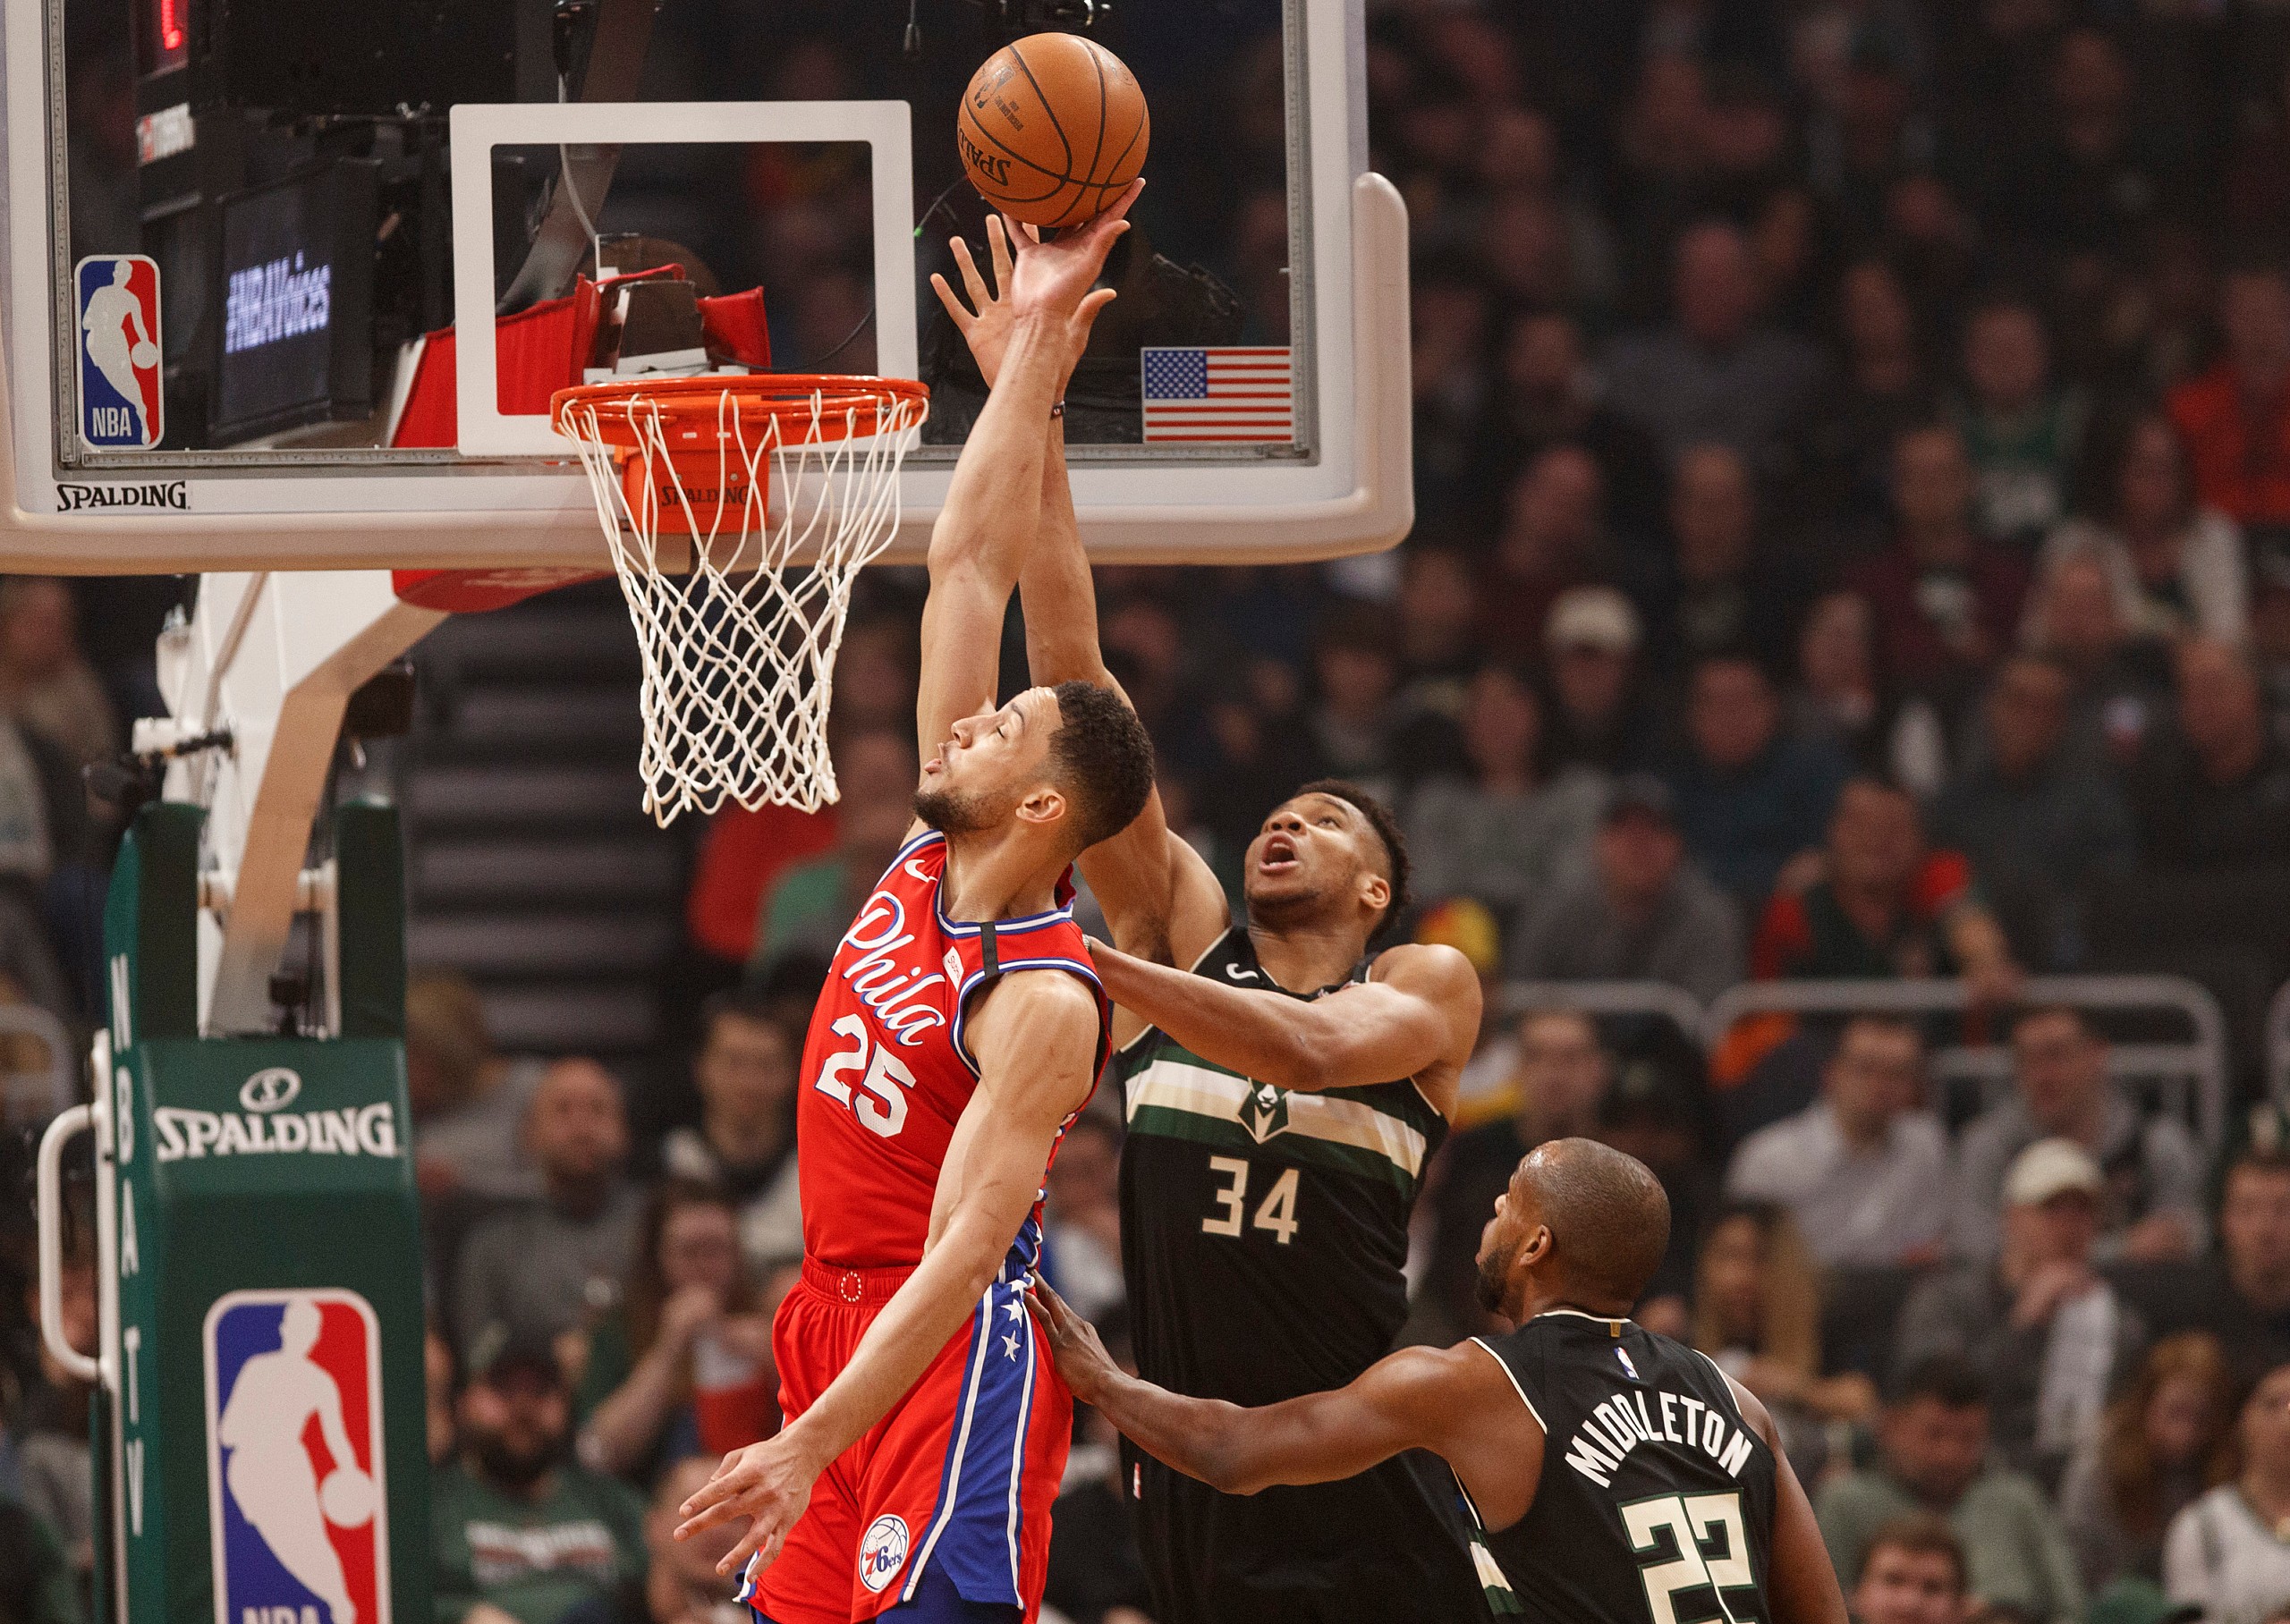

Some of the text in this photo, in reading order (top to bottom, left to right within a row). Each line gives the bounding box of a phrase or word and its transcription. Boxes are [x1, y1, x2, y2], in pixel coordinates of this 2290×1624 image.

[92, 407, 131, 437] NBA
[56, 480, 186, 512] SPALDING
[828, 890, 946, 1046] Phila
[814, 1013, 917, 1138] 25
[153, 1101, 397, 1163] SPALDING
[1201, 1155, 1300, 1245] 34
[1565, 1390, 1754, 1489] MIDDLETON
[865, 1545, 903, 1577] 76ers
[1617, 1489, 1758, 1624] 22
